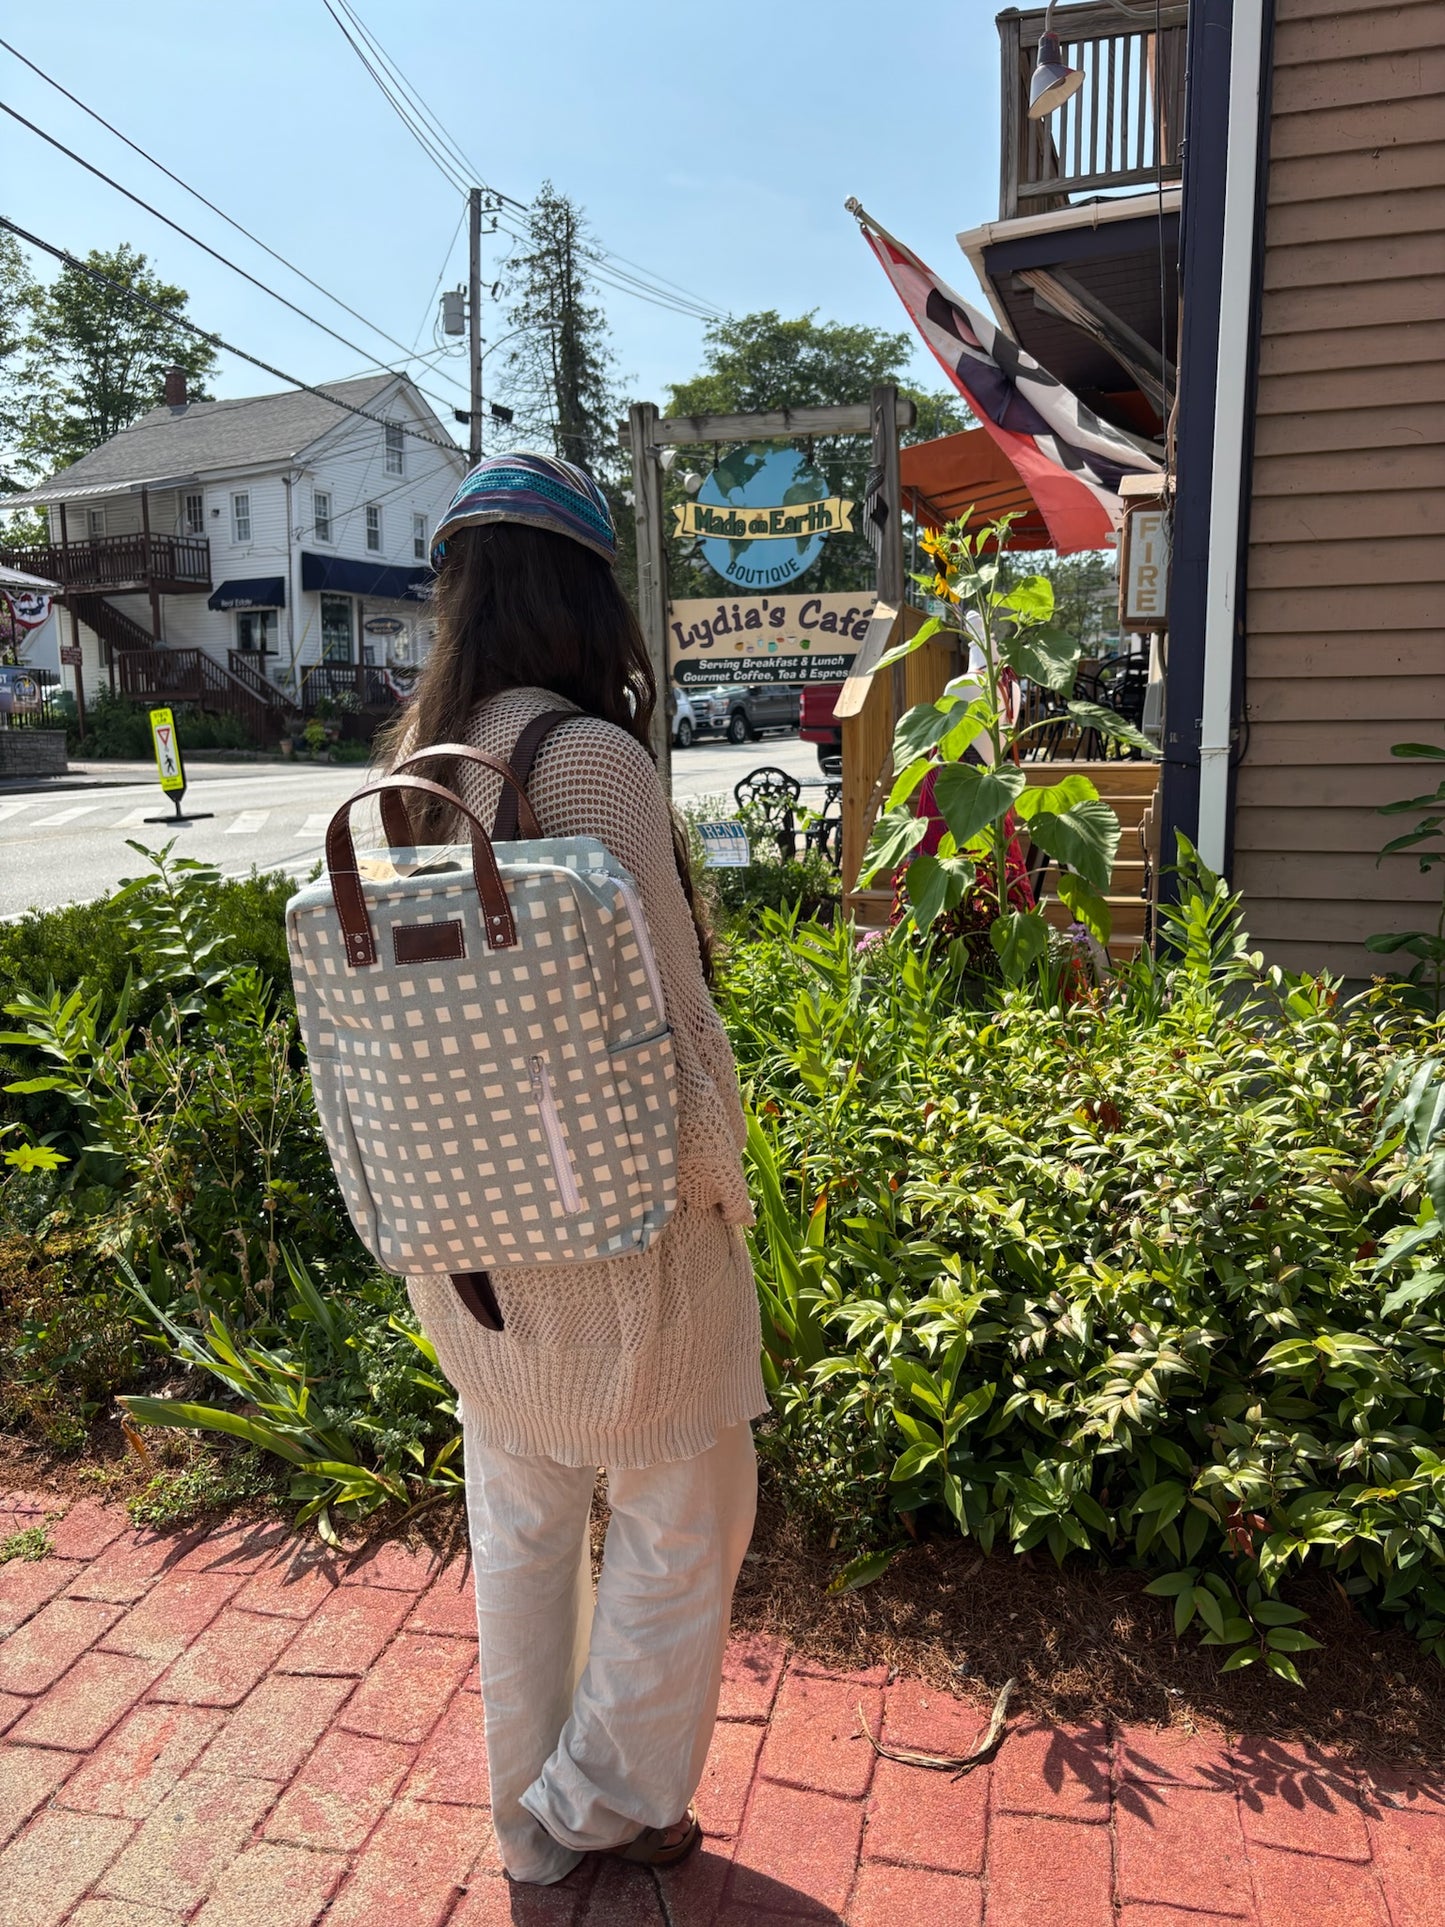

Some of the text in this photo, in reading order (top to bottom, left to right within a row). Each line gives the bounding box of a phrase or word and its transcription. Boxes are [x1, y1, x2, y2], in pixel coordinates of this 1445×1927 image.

[694, 502, 833, 537] Made on Earth
[725, 557, 801, 585] BOUTIQUE
[1135, 516, 1161, 612] FIRE
[671, 599, 874, 650] Lydia's Café
[682, 671, 731, 683] Gourmet
[731, 669, 775, 682] Coffee,
[778, 669, 797, 680] Tea
[798, 669, 808, 679] &
[699, 655, 845, 671] Serving Breakfast & Lunch
[702, 822, 743, 838] RENT
